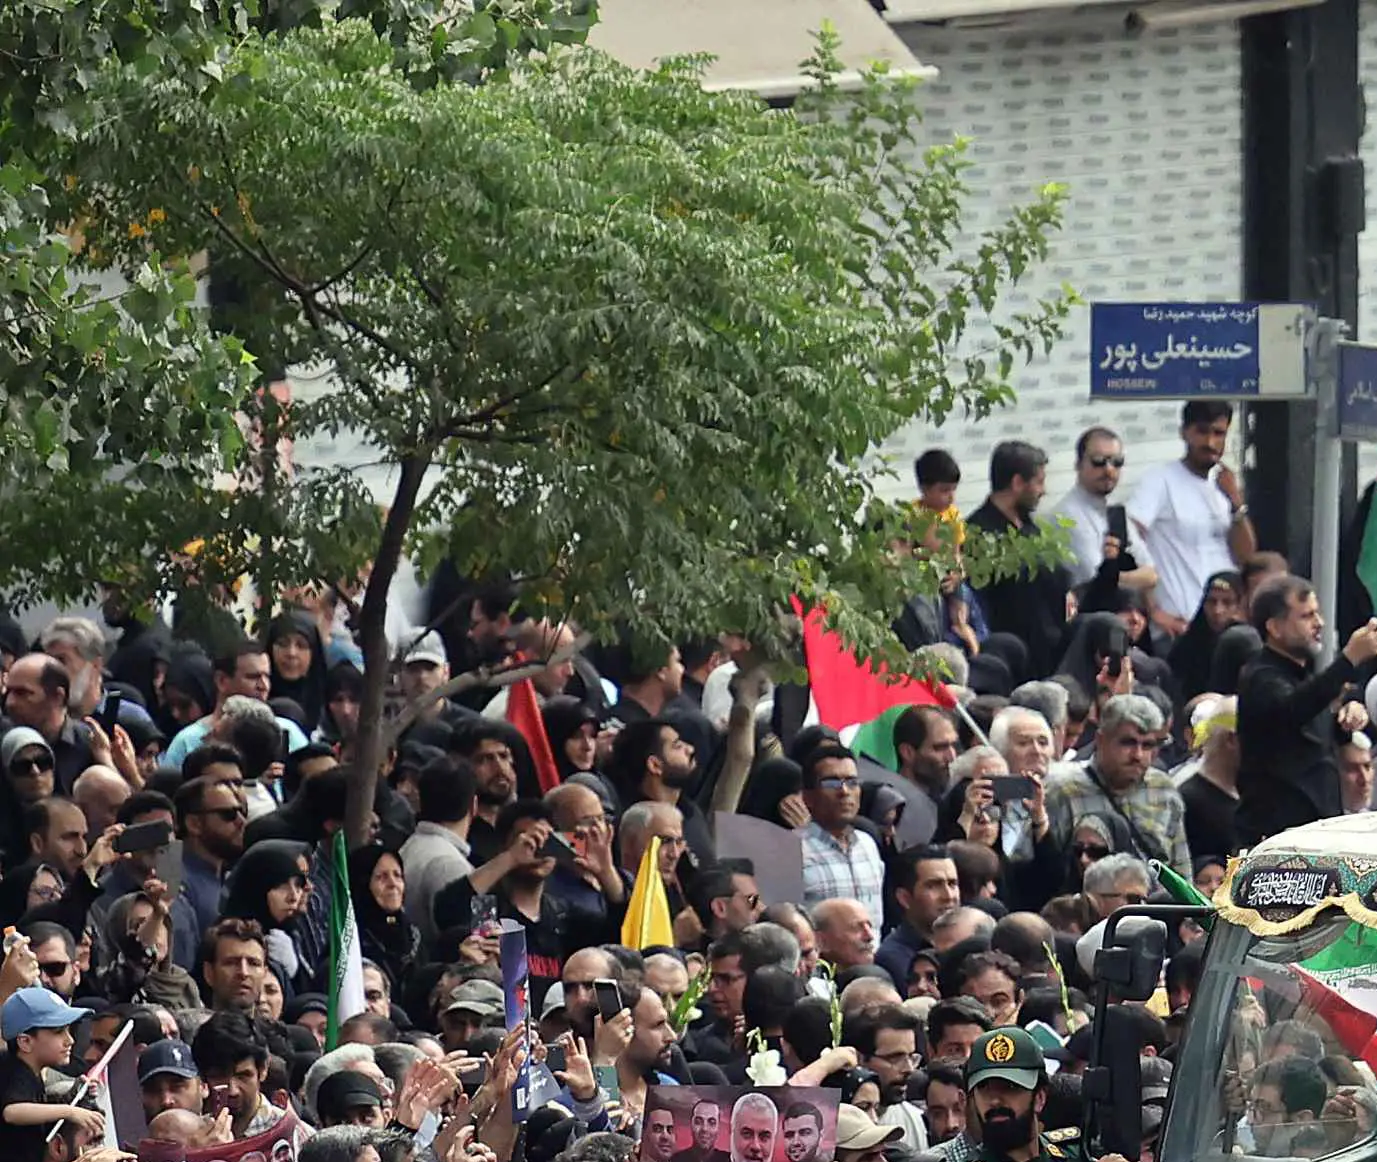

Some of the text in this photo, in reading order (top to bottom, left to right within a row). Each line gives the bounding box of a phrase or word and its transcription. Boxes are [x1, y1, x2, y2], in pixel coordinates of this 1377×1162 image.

[1197, 307, 1228, 321] شهید
[1099, 333, 1252, 373] حسینعلی پور
